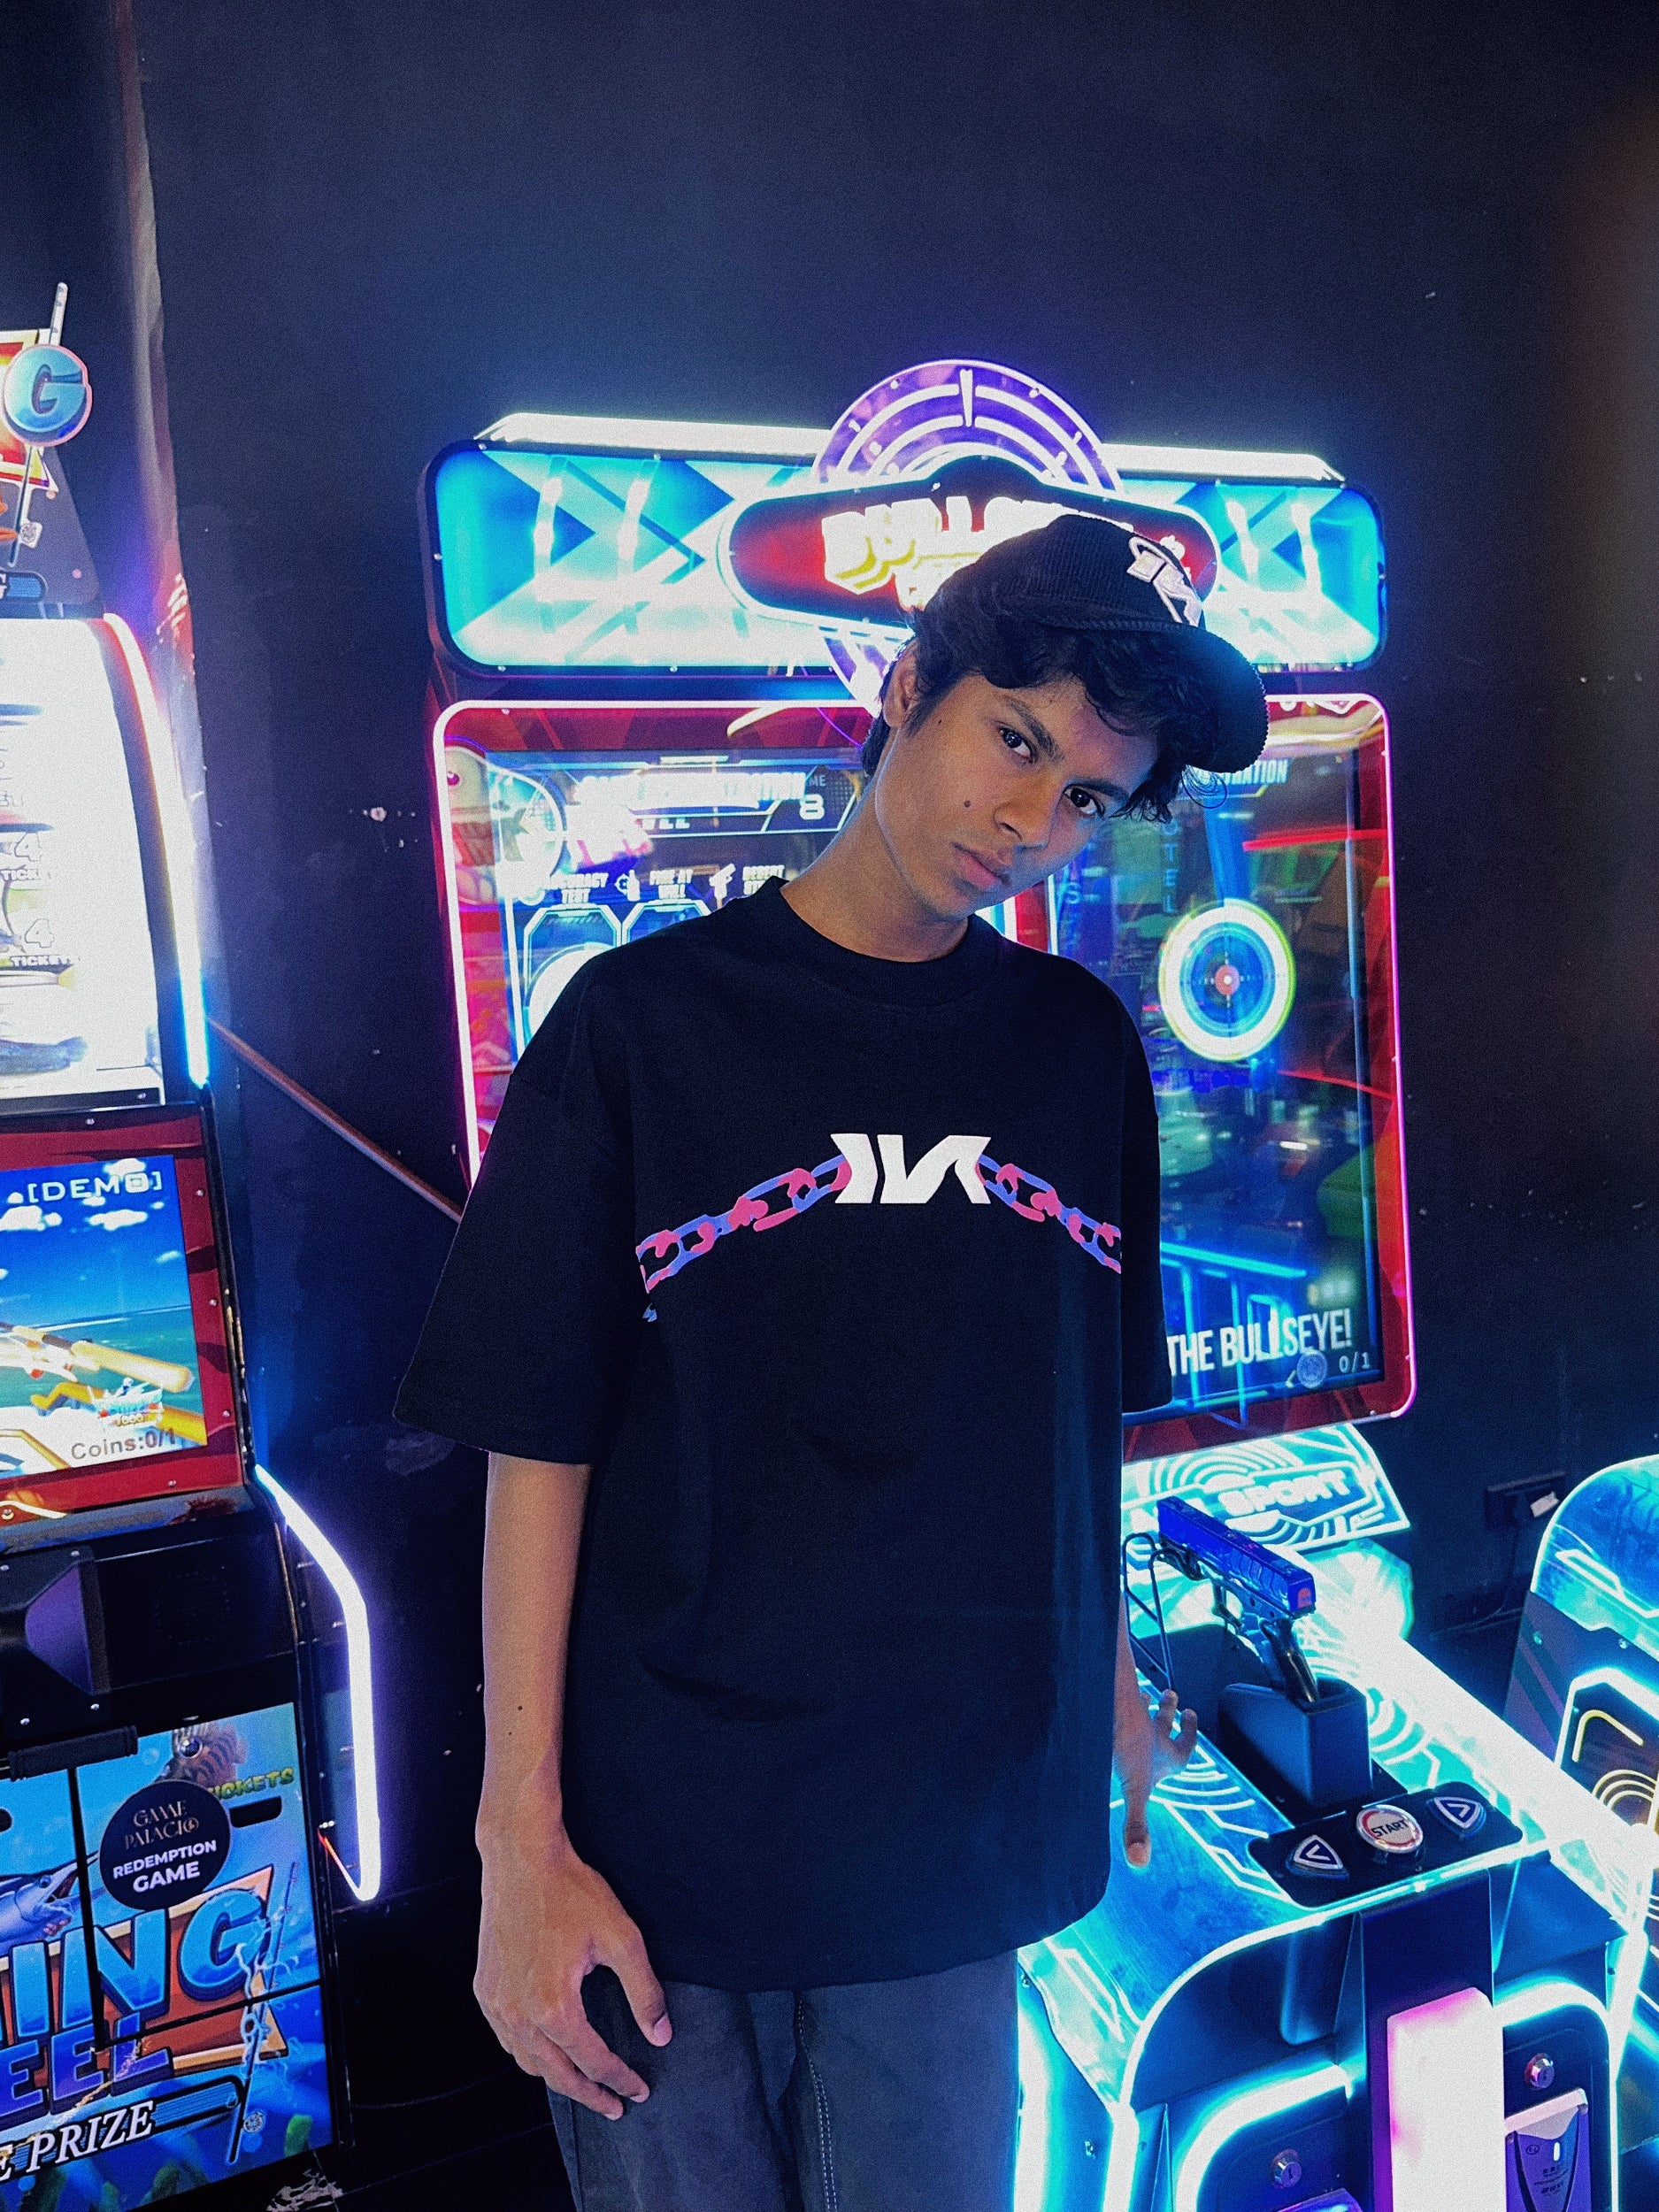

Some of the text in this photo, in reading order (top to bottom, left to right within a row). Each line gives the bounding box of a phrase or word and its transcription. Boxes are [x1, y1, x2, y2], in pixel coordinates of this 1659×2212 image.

[1166, 1330, 1215, 1377] THE
[1339, 1352, 1371, 1373] 0/1
[71, 1427, 175, 1461] Coins:0/1
[134, 1799, 187, 1829] GAME
[1371, 1819, 1409, 1837] START
[112, 1839, 218, 1880] REDEMPTION
[133, 1861, 201, 1893] GAME
[26, 2100, 154, 2174] PRIZE
